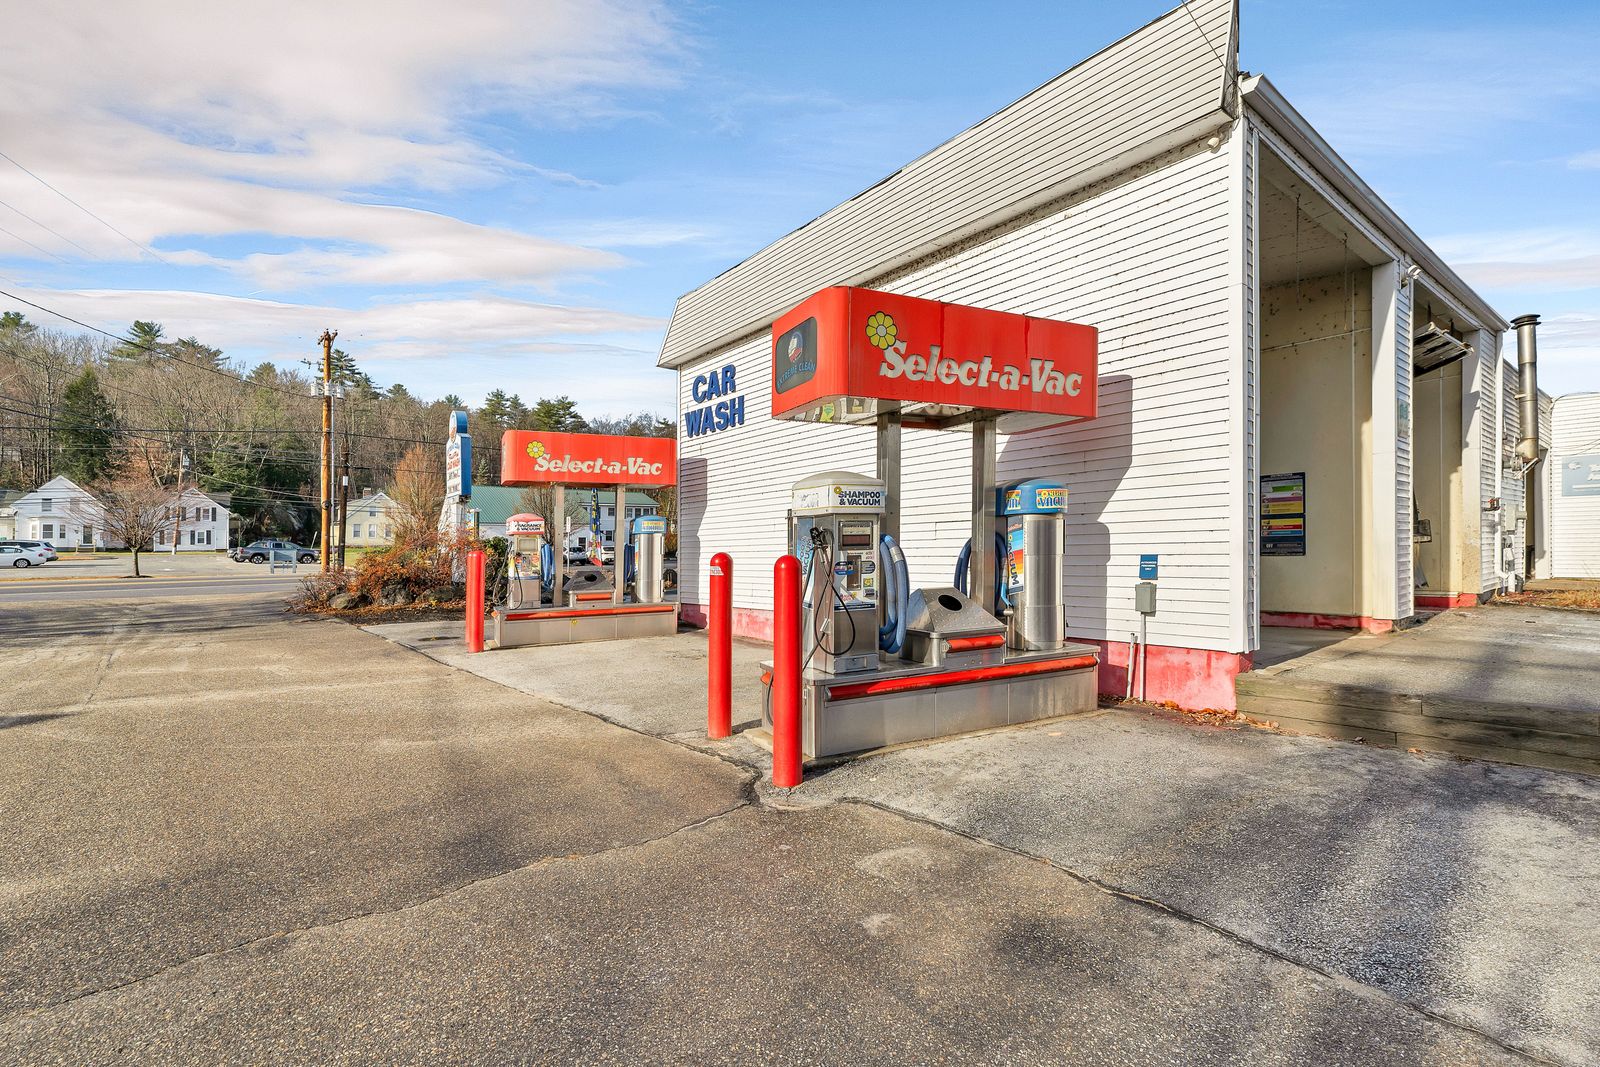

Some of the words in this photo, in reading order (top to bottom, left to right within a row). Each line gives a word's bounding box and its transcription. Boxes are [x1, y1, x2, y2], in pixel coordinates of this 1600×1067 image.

[798, 360, 817, 375] CLEAN
[879, 339, 1083, 397] Select-a-Vac
[692, 364, 737, 404] CAR
[684, 395, 745, 438] WASH
[534, 453, 663, 476] Select-a-Vac
[838, 490, 881, 499] SHAMPOO
[839, 498, 846, 506] &
[847, 498, 881, 506] VACUUM
